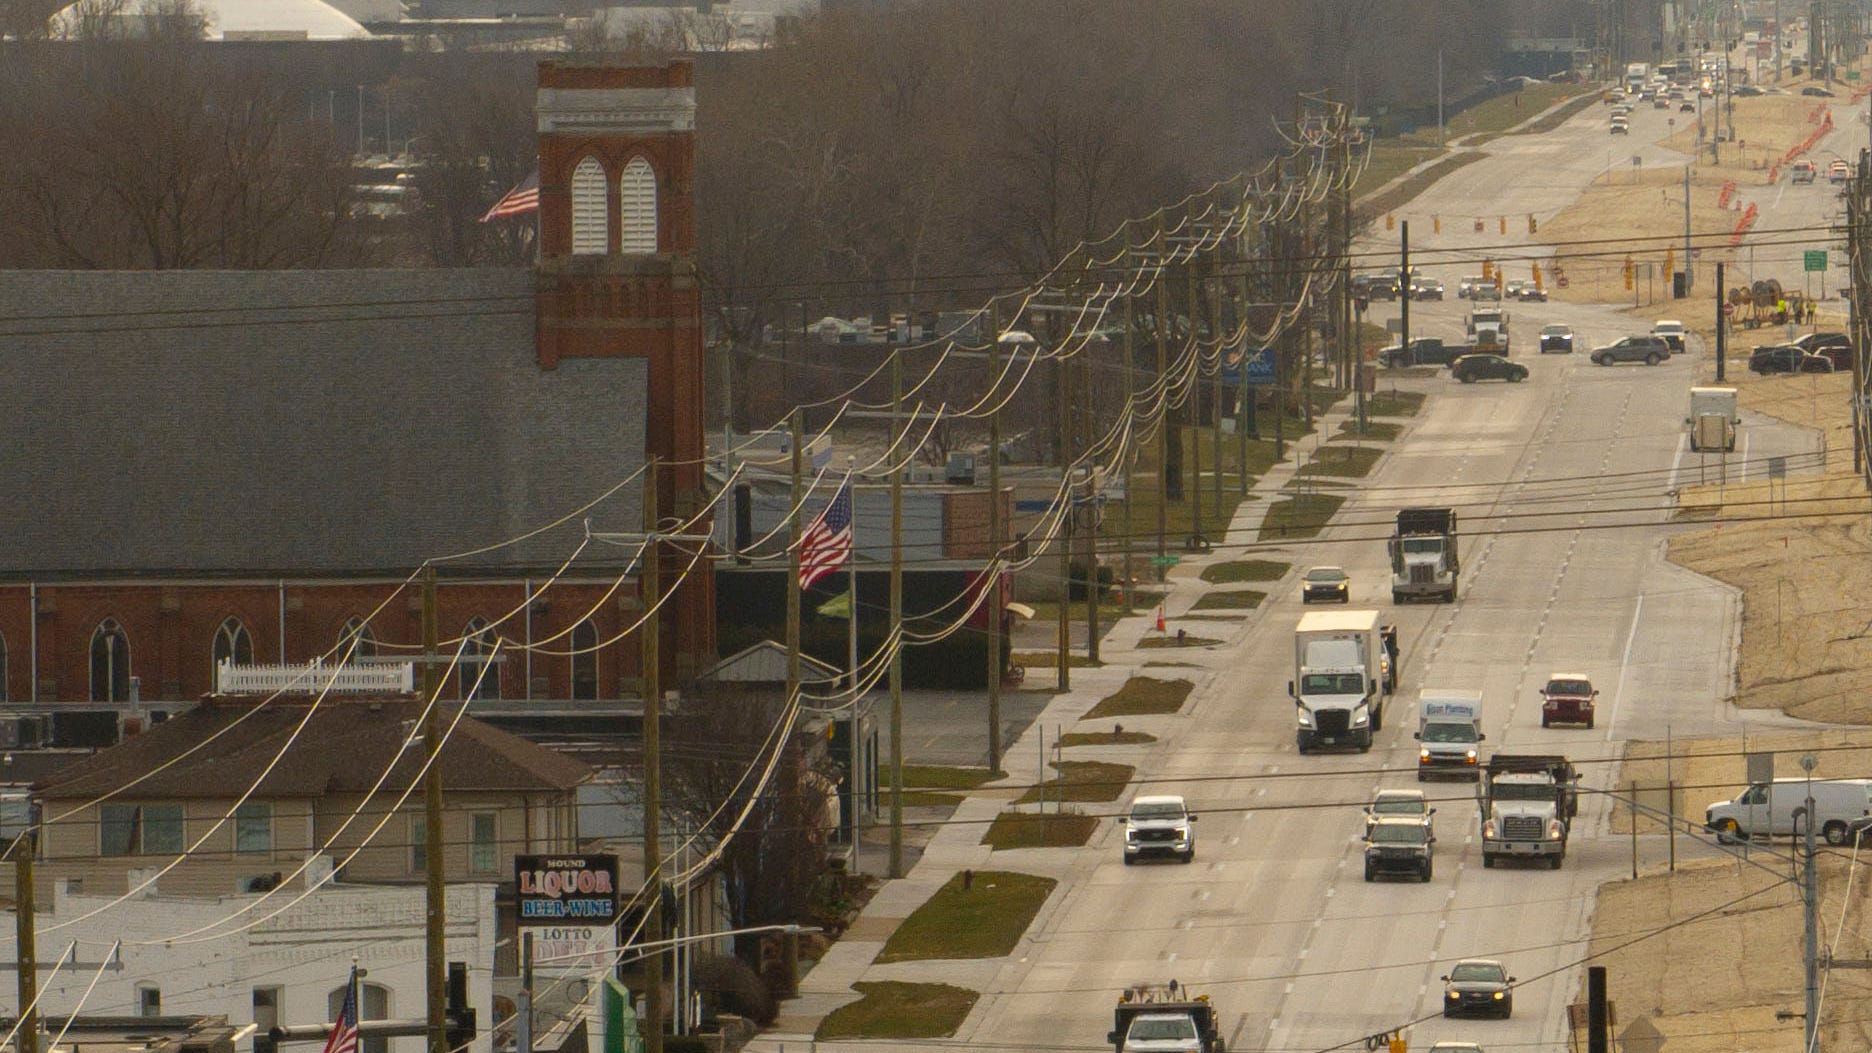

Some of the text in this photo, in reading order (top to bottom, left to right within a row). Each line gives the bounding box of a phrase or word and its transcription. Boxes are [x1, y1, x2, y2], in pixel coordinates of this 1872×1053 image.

[546, 859, 586, 868] MOUND
[519, 869, 613, 898] LIQUOR
[543, 927, 593, 941] LOTTO
